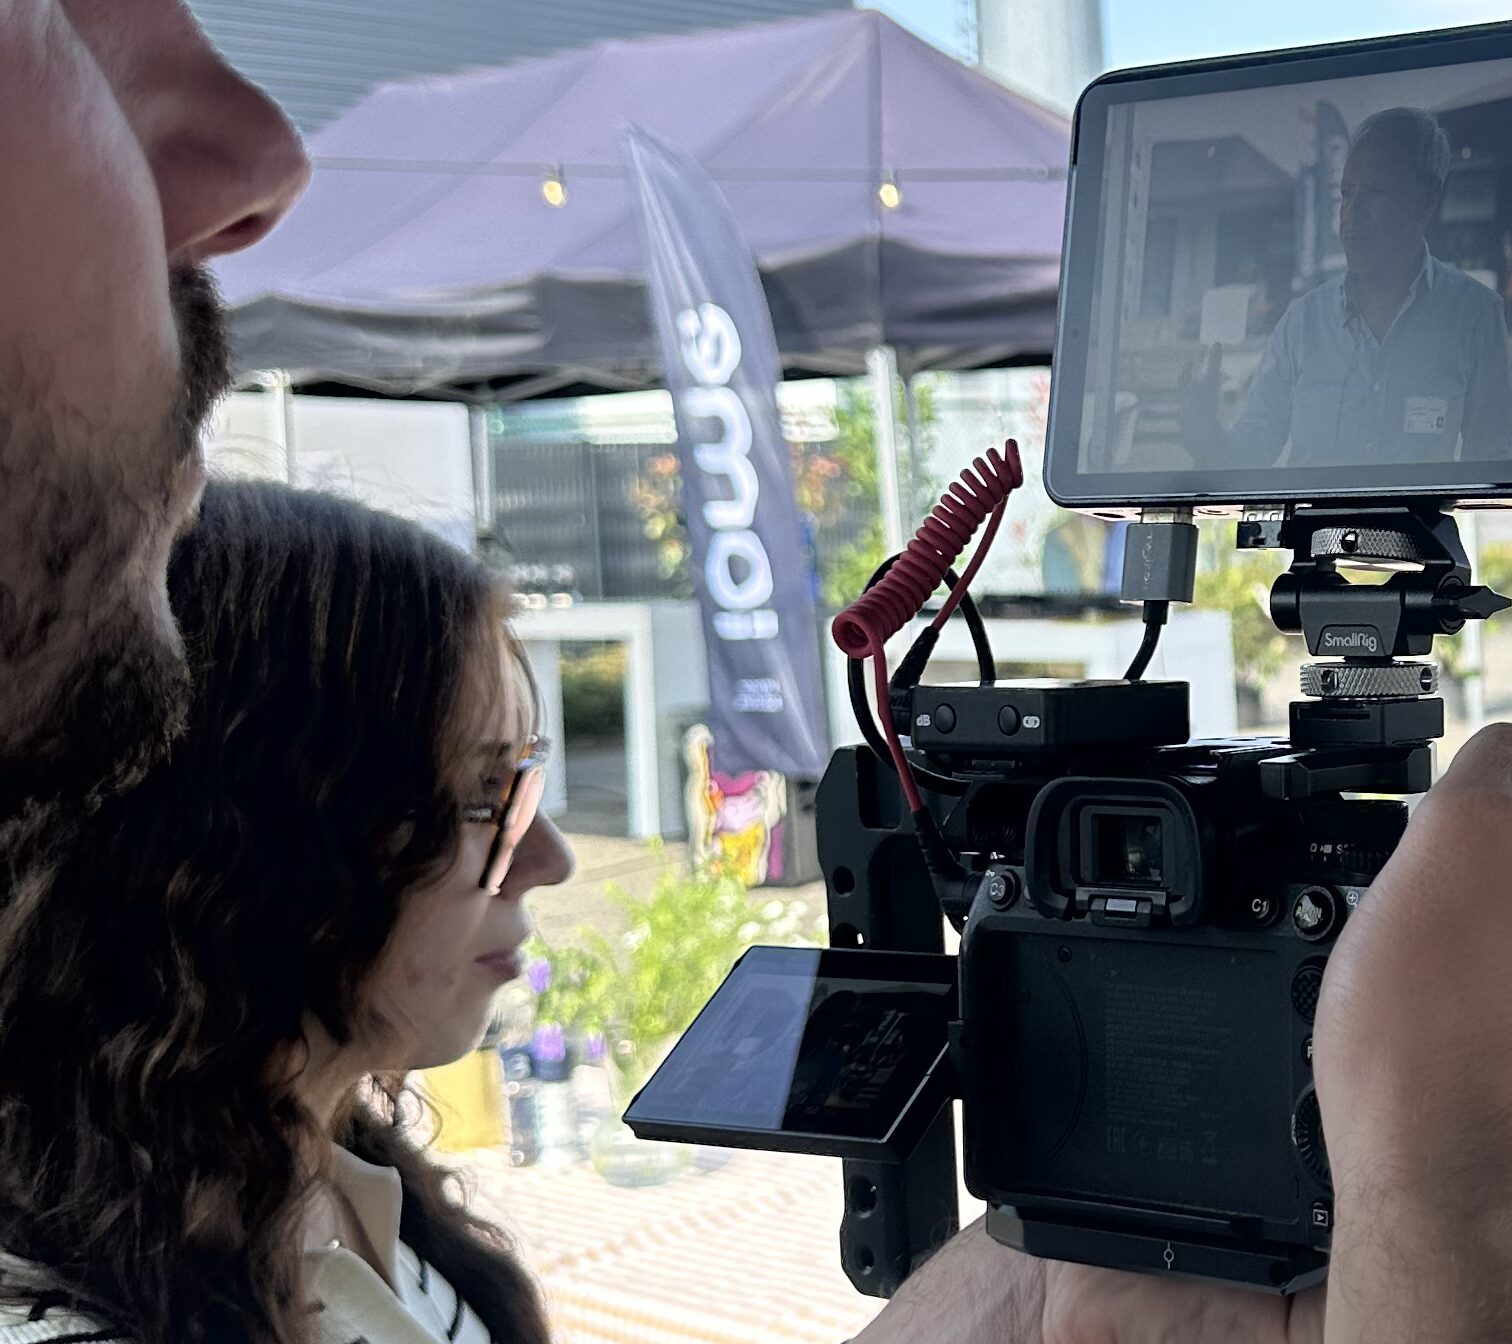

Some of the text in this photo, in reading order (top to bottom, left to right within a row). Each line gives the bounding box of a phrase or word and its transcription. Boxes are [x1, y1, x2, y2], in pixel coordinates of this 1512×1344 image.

[1325, 633, 1377, 652] SmallRig
[916, 714, 931, 726] dB
[1251, 898, 1269, 913] C1
